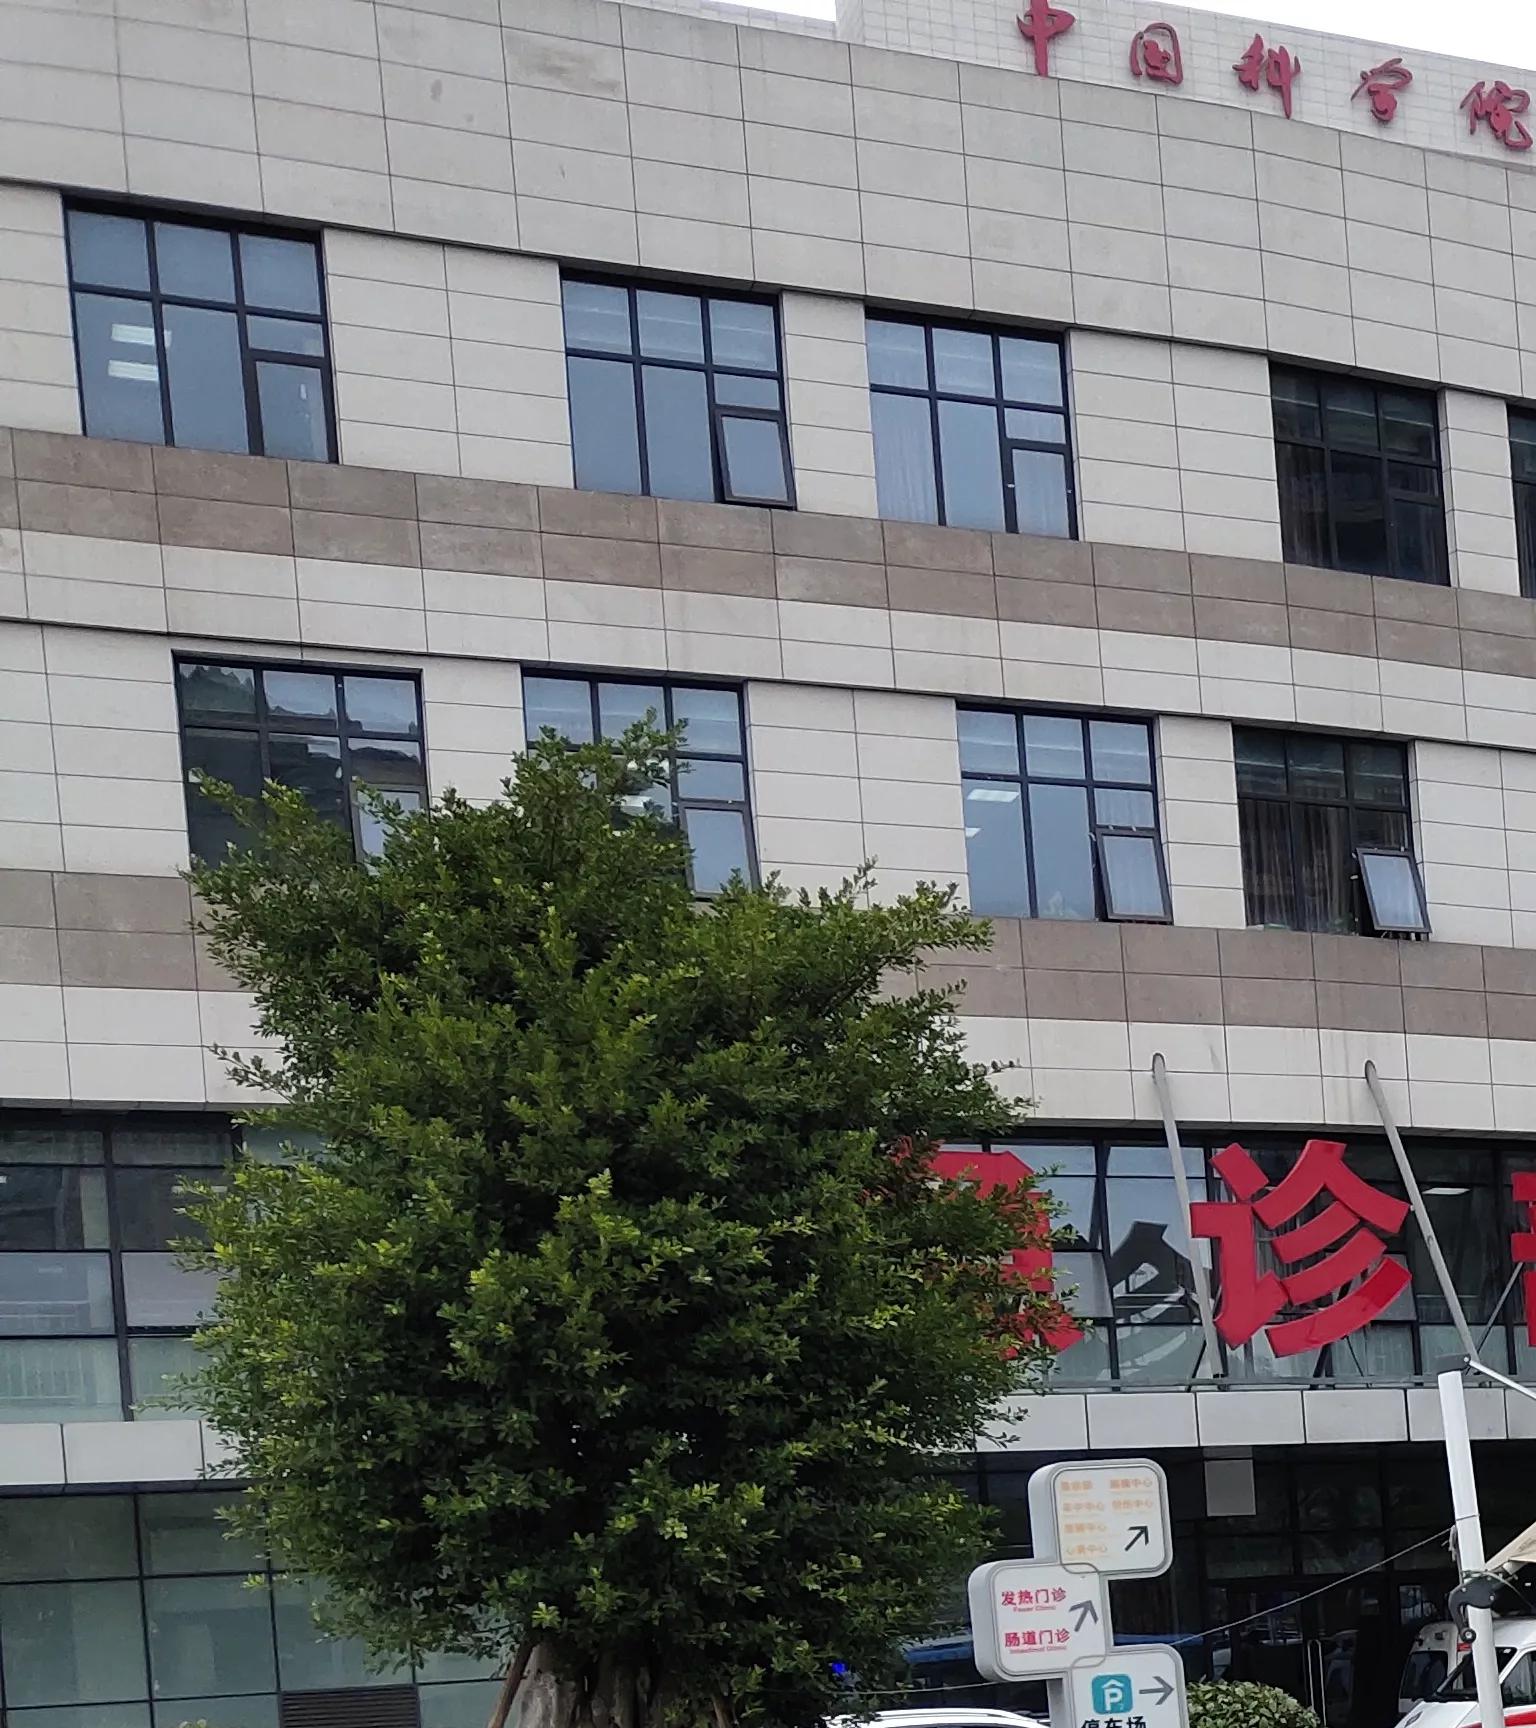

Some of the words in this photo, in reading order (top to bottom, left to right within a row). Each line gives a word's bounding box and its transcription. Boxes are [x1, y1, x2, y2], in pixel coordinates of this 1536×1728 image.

[1002, 1587, 1066, 1606] 发热门诊
[1005, 1628, 1070, 1648] 肠道门诊
